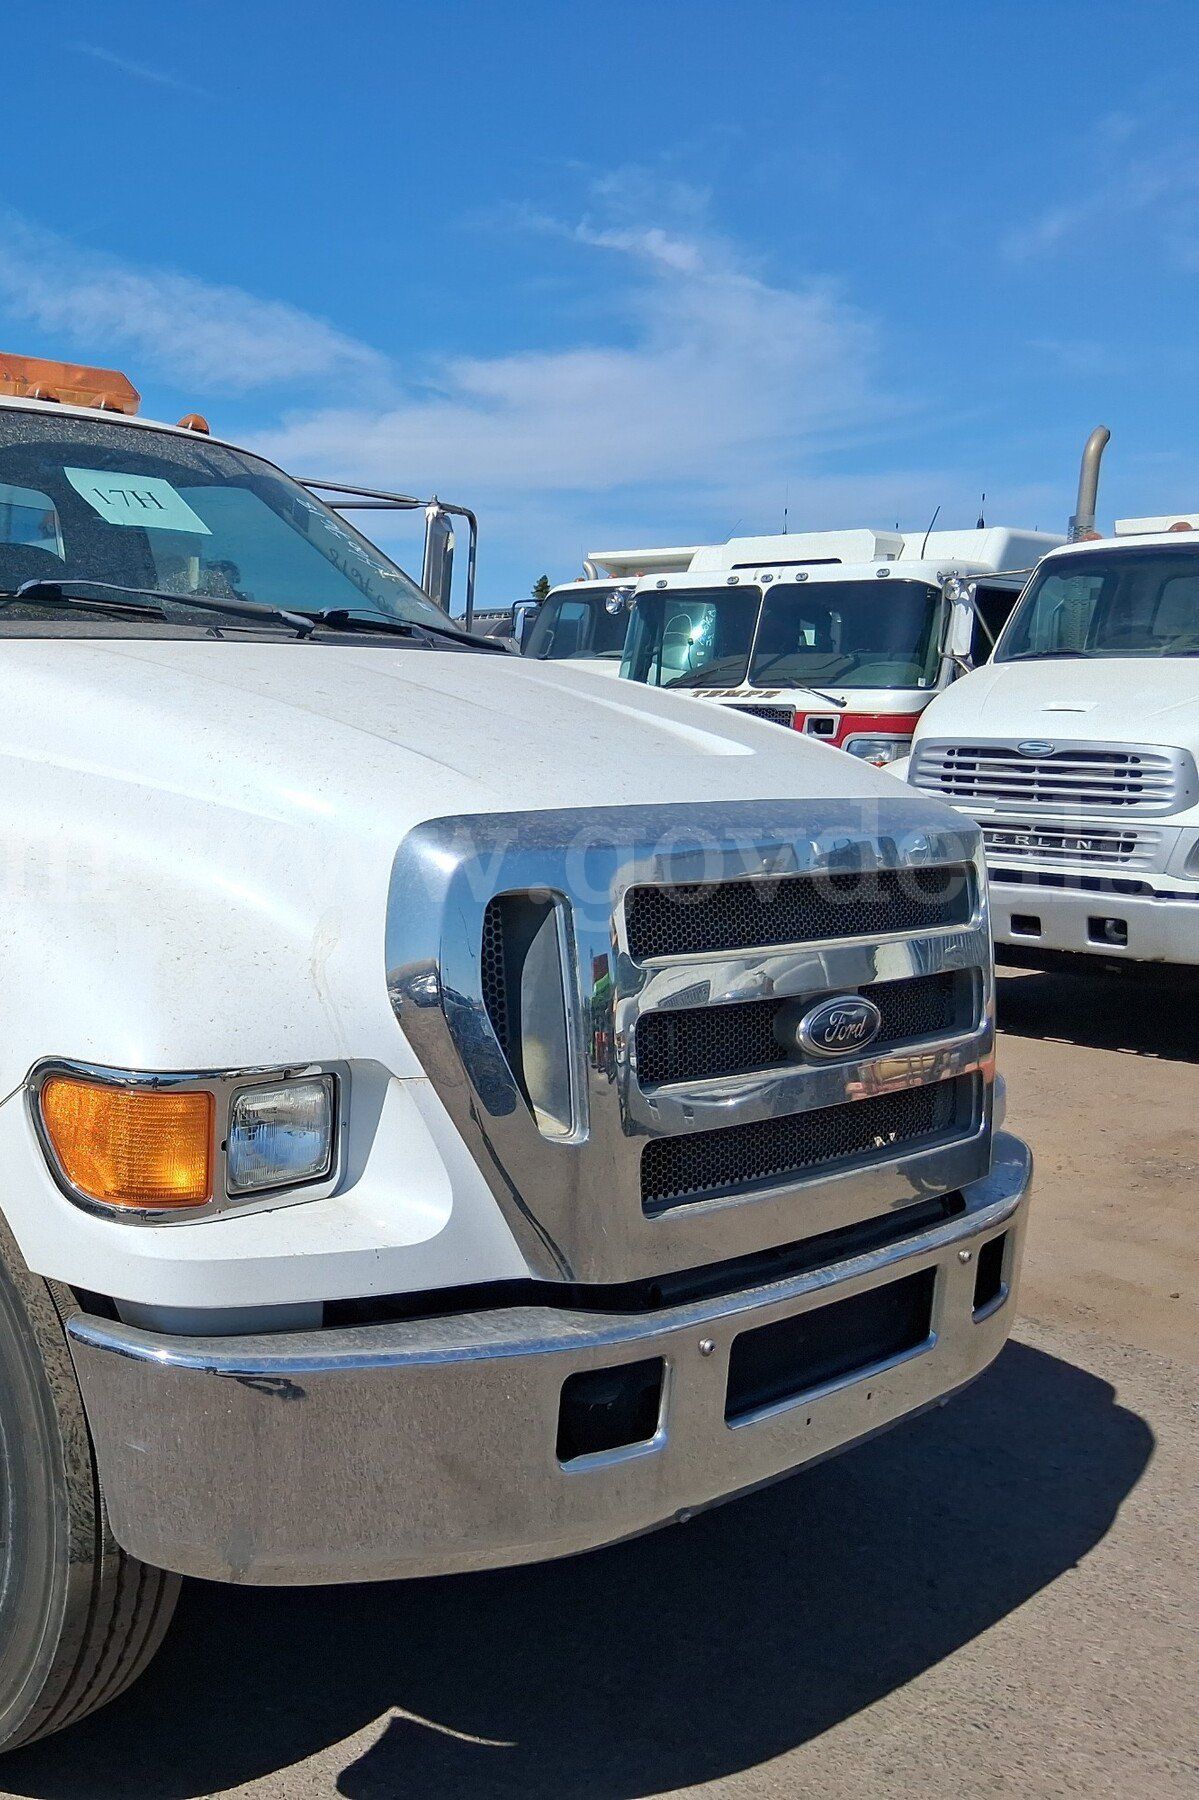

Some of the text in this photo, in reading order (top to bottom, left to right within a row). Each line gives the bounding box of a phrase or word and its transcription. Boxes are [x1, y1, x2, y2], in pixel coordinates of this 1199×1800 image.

[91, 487, 168, 510] 17H
[991, 833, 1093, 850] ERLIN
[824, 1010, 868, 1043] Ford
